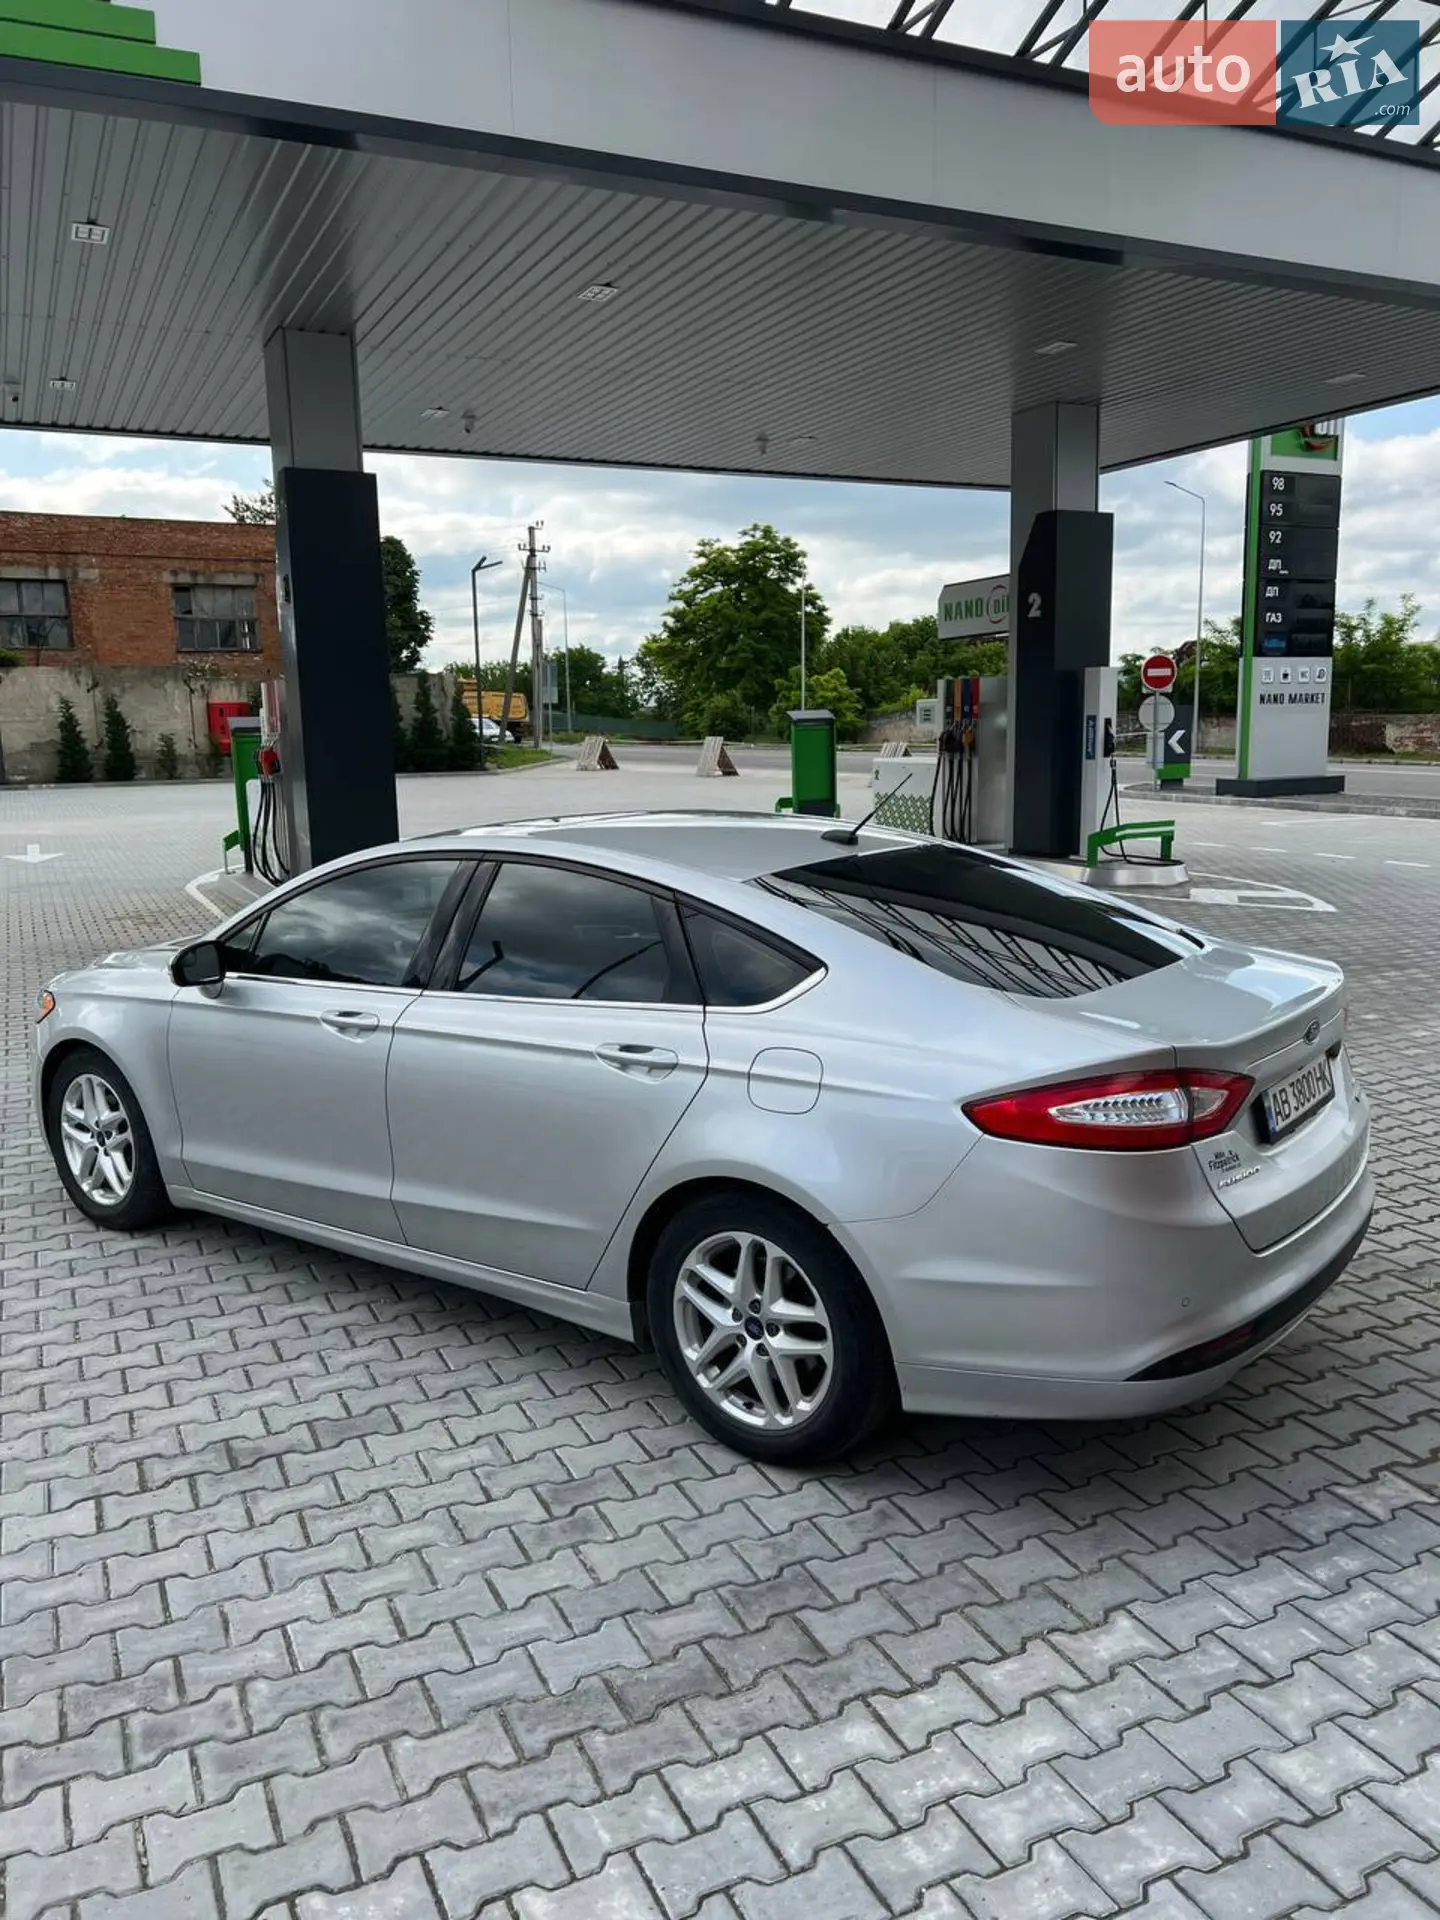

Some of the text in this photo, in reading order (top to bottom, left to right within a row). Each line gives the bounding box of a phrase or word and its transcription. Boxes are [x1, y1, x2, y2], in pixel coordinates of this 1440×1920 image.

[1272, 477, 1285, 491] 98
[1269, 503, 1283, 517] 95
[1268, 530, 1282, 544] 92
[944, 597, 984, 622] NANO
[1027, 592, 1042, 618] 2
[1265, 612, 1283, 623] ГАЗ
[1260, 692, 1326, 705] NANO MARKET
[1272, 1087, 1292, 1126] AB
